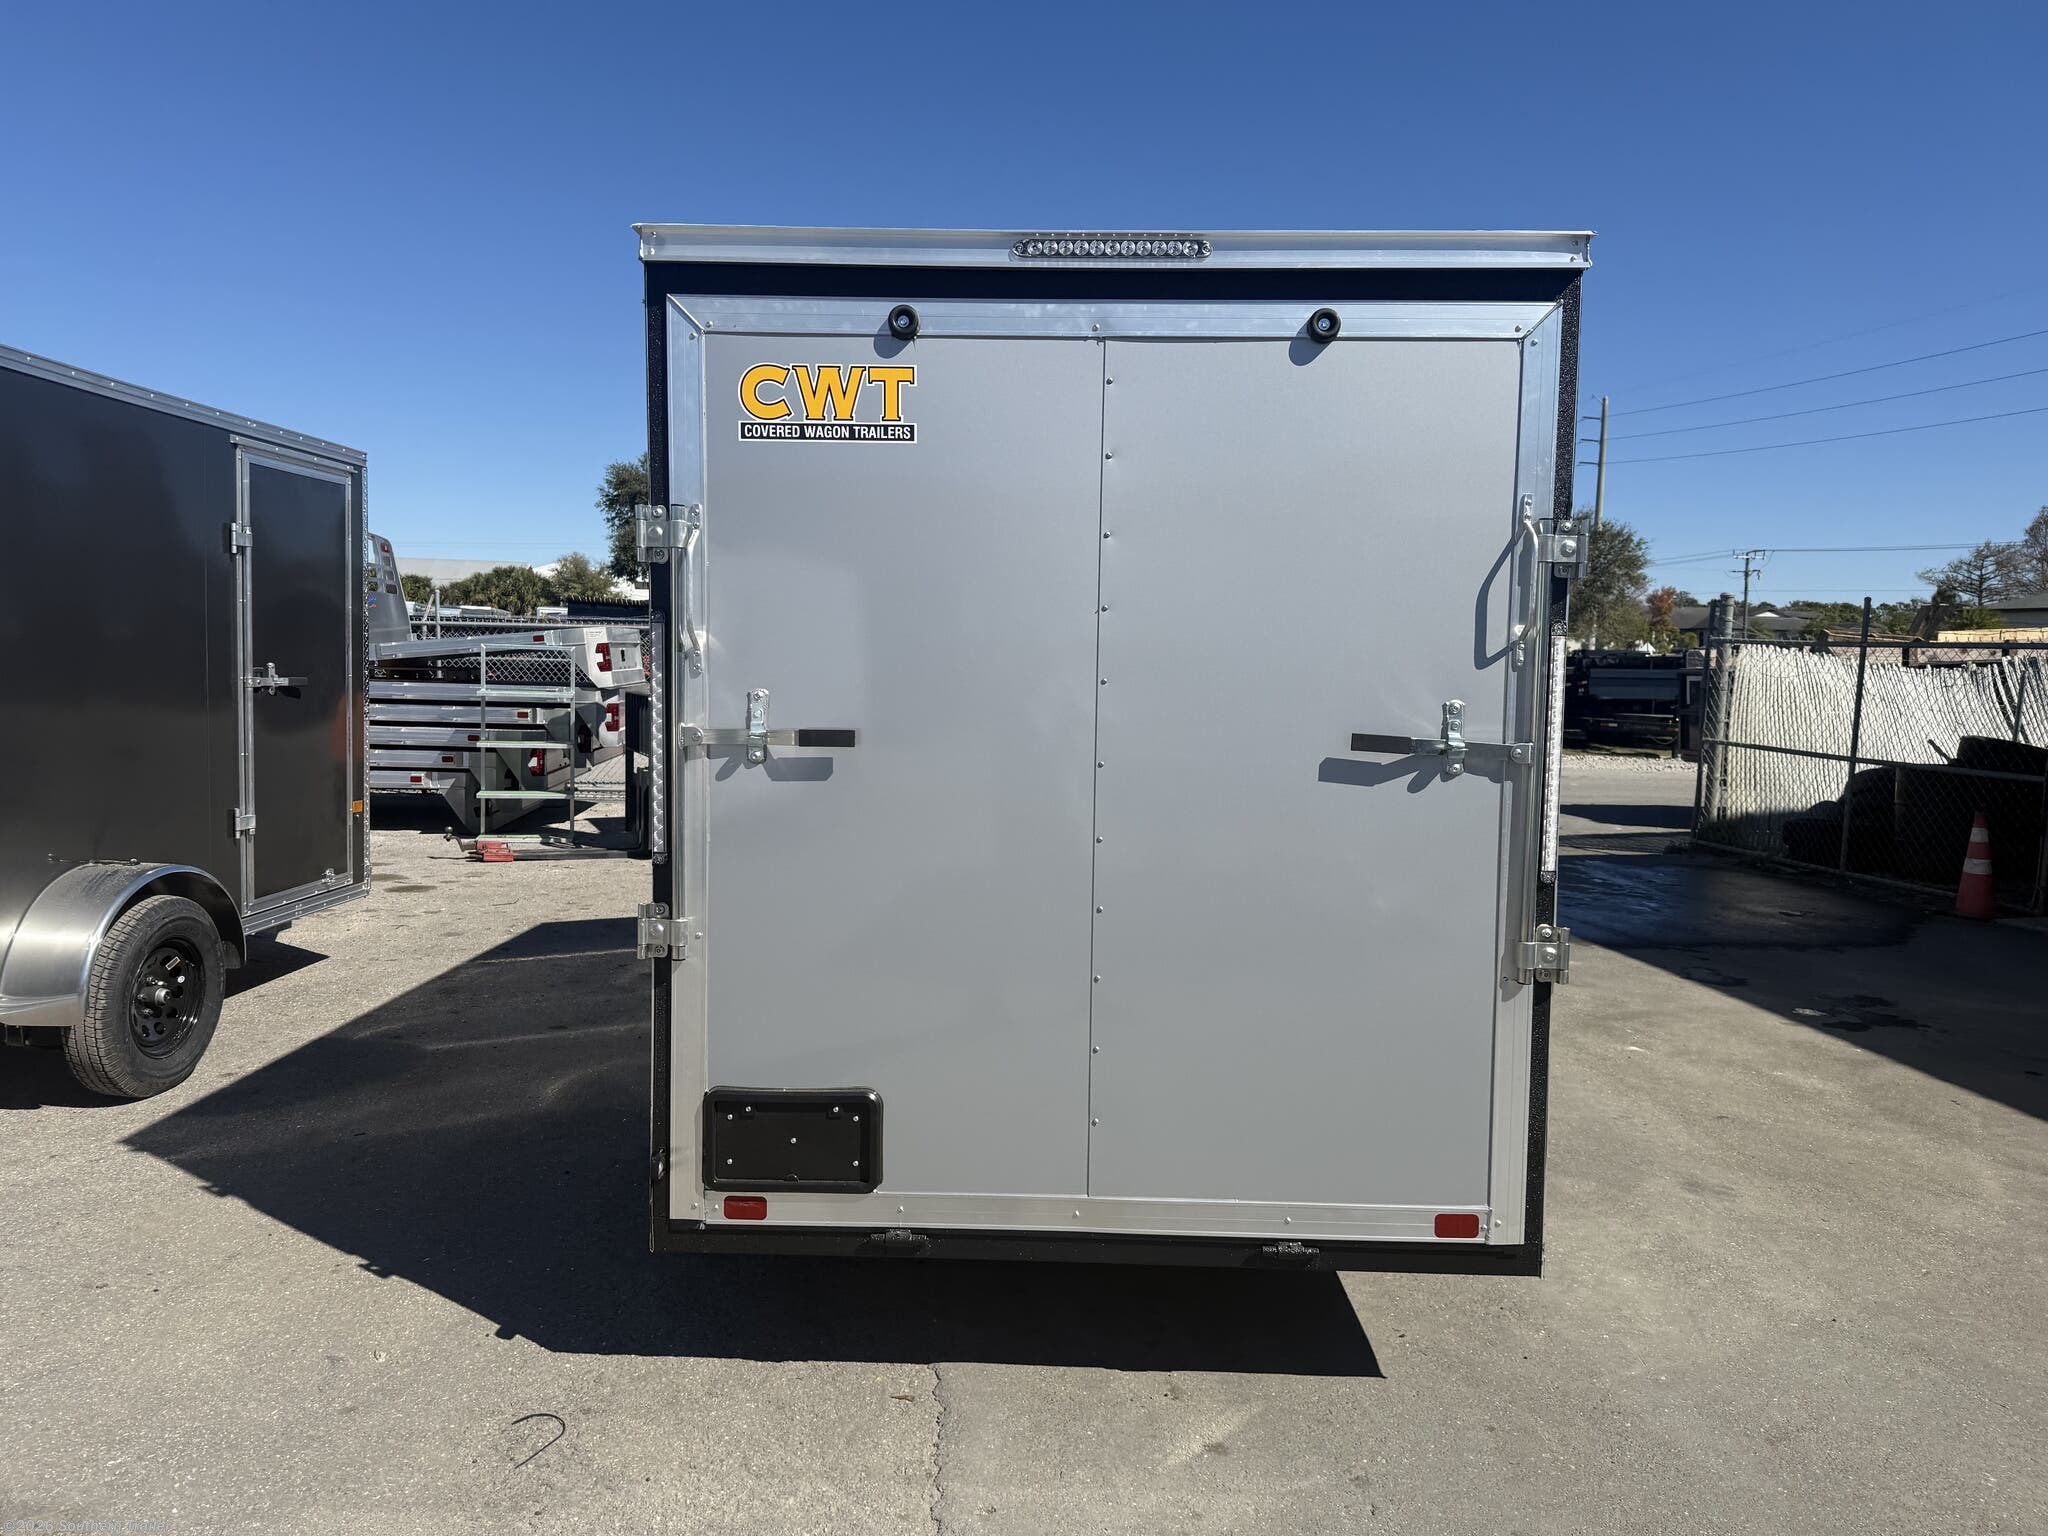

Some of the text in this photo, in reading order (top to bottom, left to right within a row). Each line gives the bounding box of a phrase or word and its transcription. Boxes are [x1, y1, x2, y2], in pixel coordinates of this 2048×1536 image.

[739, 363, 916, 422] CWT
[744, 424, 911, 439] COVERED WAGON TRAILERS
